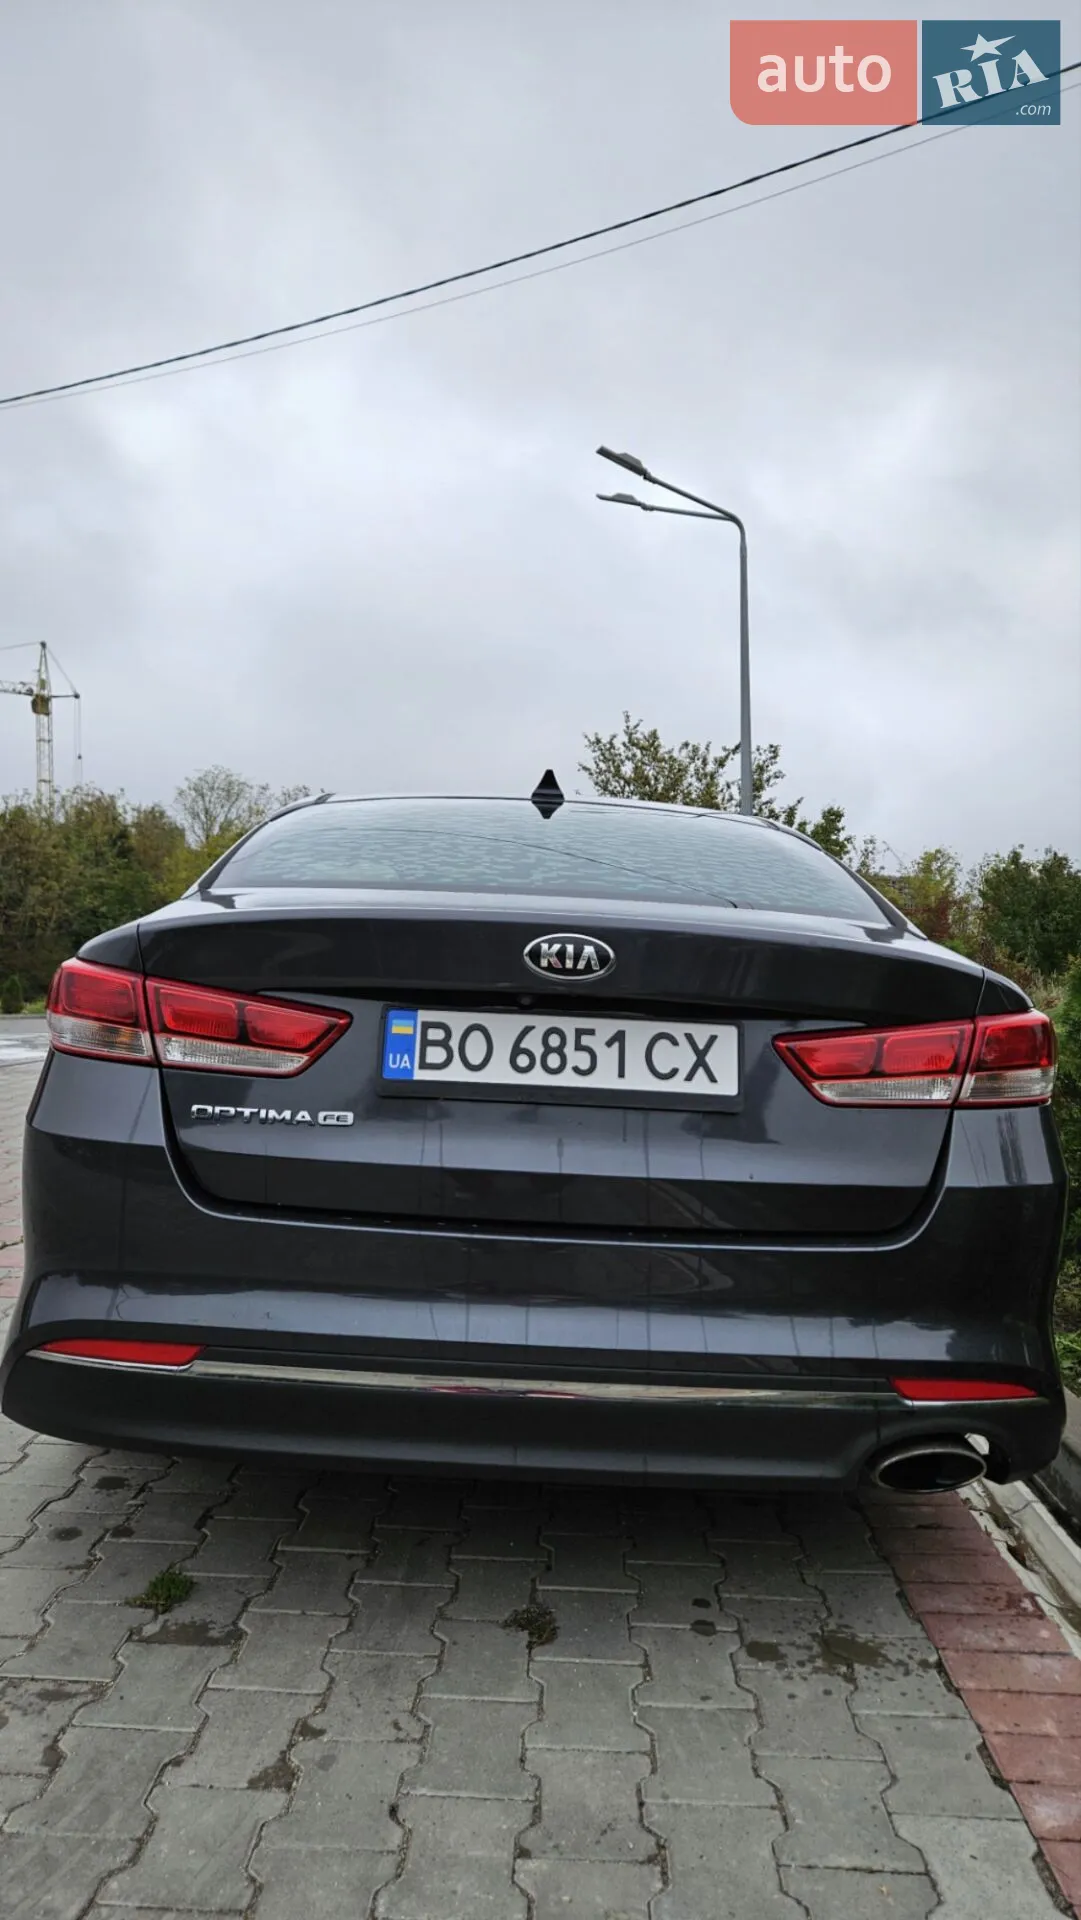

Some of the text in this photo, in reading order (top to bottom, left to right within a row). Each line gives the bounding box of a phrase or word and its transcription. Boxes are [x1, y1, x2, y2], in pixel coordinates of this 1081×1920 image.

[540, 942, 600, 970] KIA
[388, 1052, 412, 1070] UA
[418, 1020, 719, 1083] BO 6851 CX
[191, 1104, 316, 1126] OPTIMA
